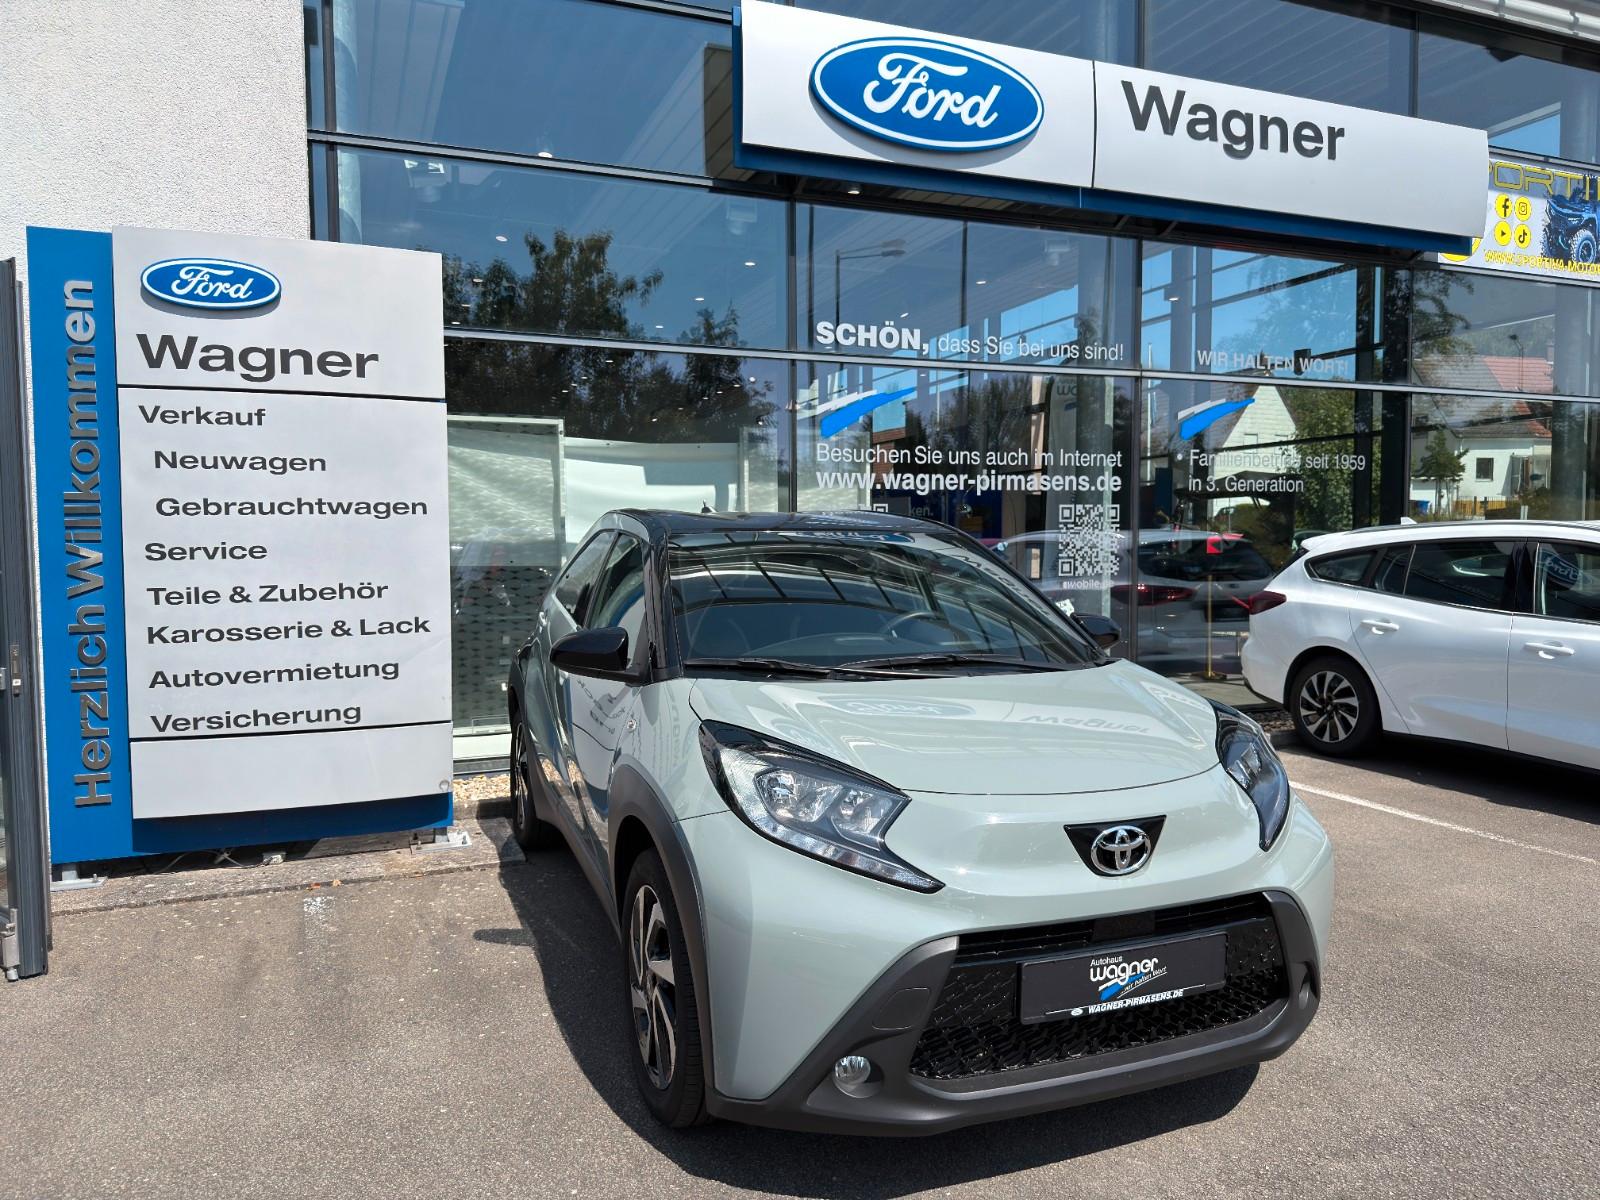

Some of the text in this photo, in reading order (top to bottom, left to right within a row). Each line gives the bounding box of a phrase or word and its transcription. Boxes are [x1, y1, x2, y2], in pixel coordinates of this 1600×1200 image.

[862, 51, 1000, 130] Ford
[1120, 80, 1345, 161] Wagner
[1489, 160, 1600, 203] ORTI
[816, 321, 1124, 361] SCHÖN, dass Sie bei uns sind!
[136, 333, 379, 382] Wagner
[1197, 350, 1228, 368] WIR
[1233, 352, 1295, 371] HALTEN
[138, 405, 266, 426] Verkauf
[154, 450, 327, 475] Neuwagen
[816, 443, 1122, 467] Besuchen Sie uns auch im Internet
[1305, 454, 1329, 469] seit
[1334, 454, 1366, 471] 1959
[816, 470, 1122, 496] www.wagner-pirmasens.de
[1188, 475, 1304, 492] in 3. Generation
[155, 498, 428, 519] Gebrauchtwagen
[64, 280, 112, 807] Herzlich Willkommen
[144, 542, 268, 561] Service
[146, 582, 388, 606] Teile & Zubehör
[147, 616, 431, 645] Karosserie & Lack
[148, 660, 400, 689] Autovermietung
[150, 704, 361, 733] Versicherung
[1089, 957, 1159, 985] wagner
[1090, 955, 1123, 967] Autohaus
[1088, 989, 1184, 1014] WAGNER-PIRMASENS.DE
